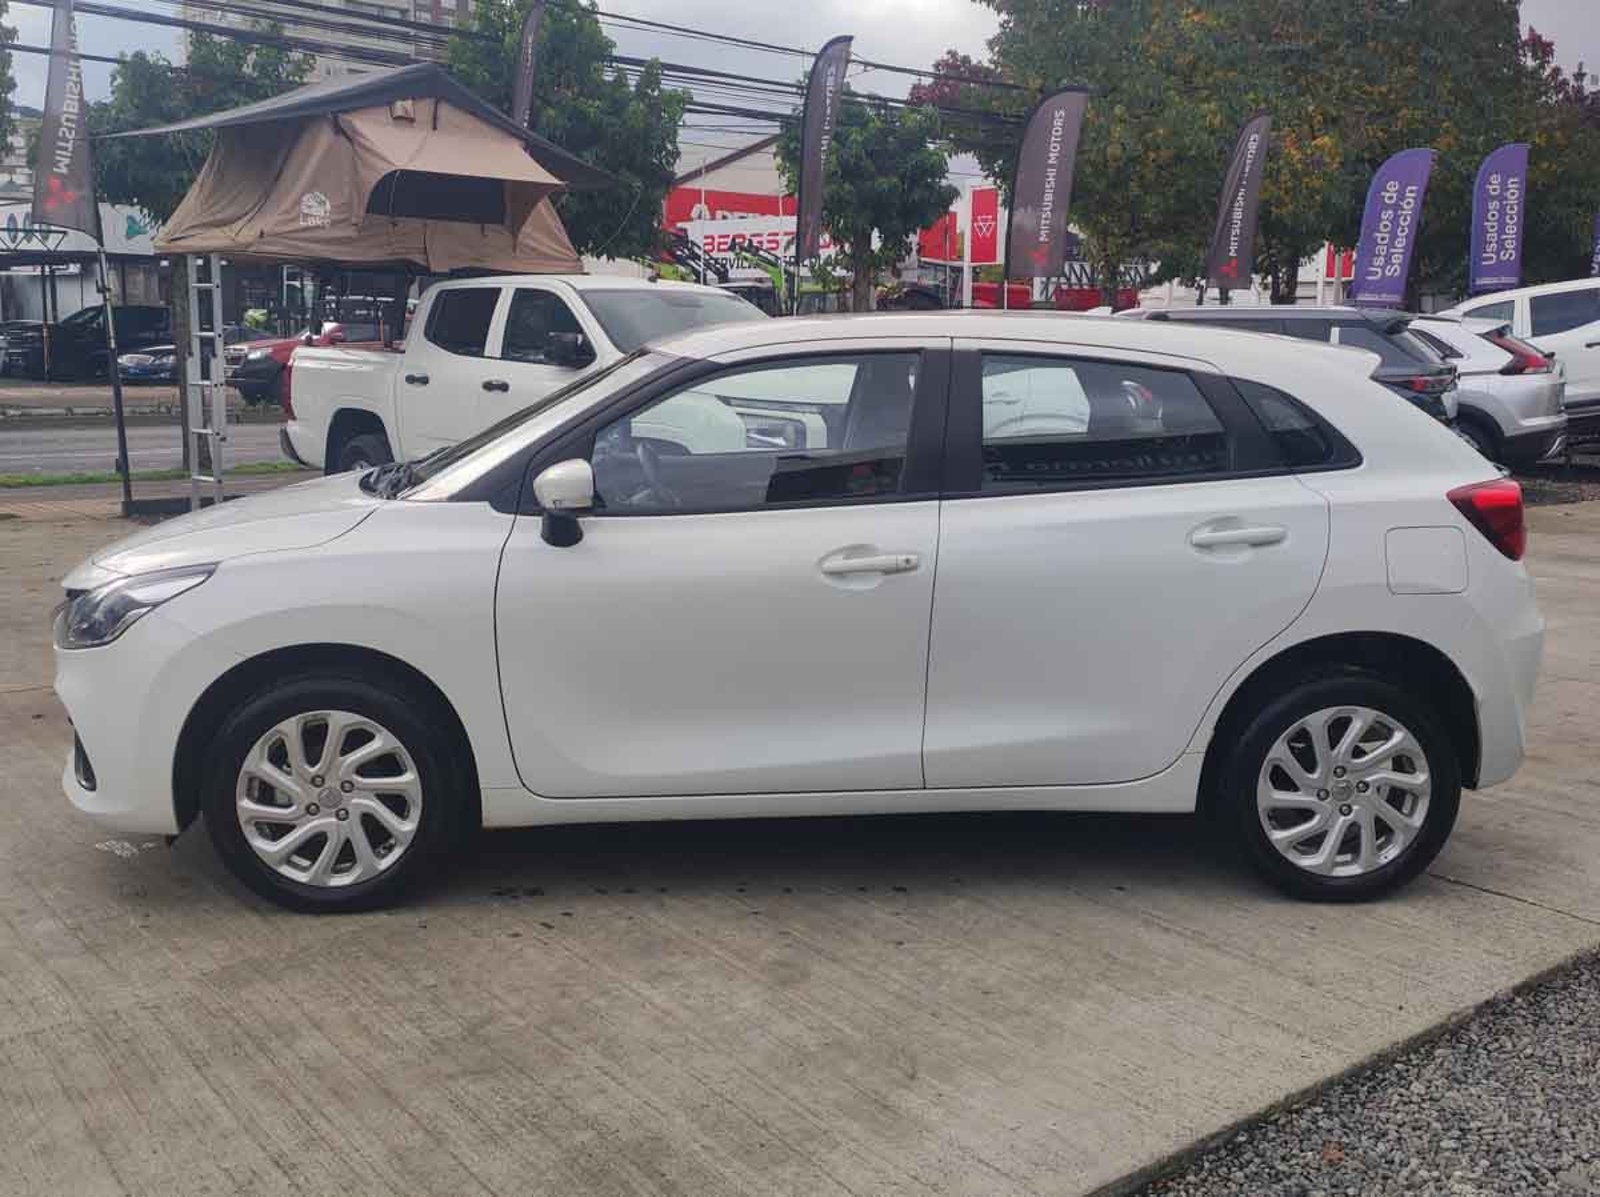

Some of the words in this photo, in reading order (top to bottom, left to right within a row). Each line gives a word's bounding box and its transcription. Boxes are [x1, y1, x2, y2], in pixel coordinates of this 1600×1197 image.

[1047, 109, 1066, 162] MOTORS
[1038, 168, 1057, 242] MITSUBISHI
[1486, 173, 1501, 196] de
[1365, 209, 1394, 281] Usados
[1381, 180, 1399, 204] de
[1385, 185, 1419, 277] Selección
[1482, 201, 1500, 265] Usados
